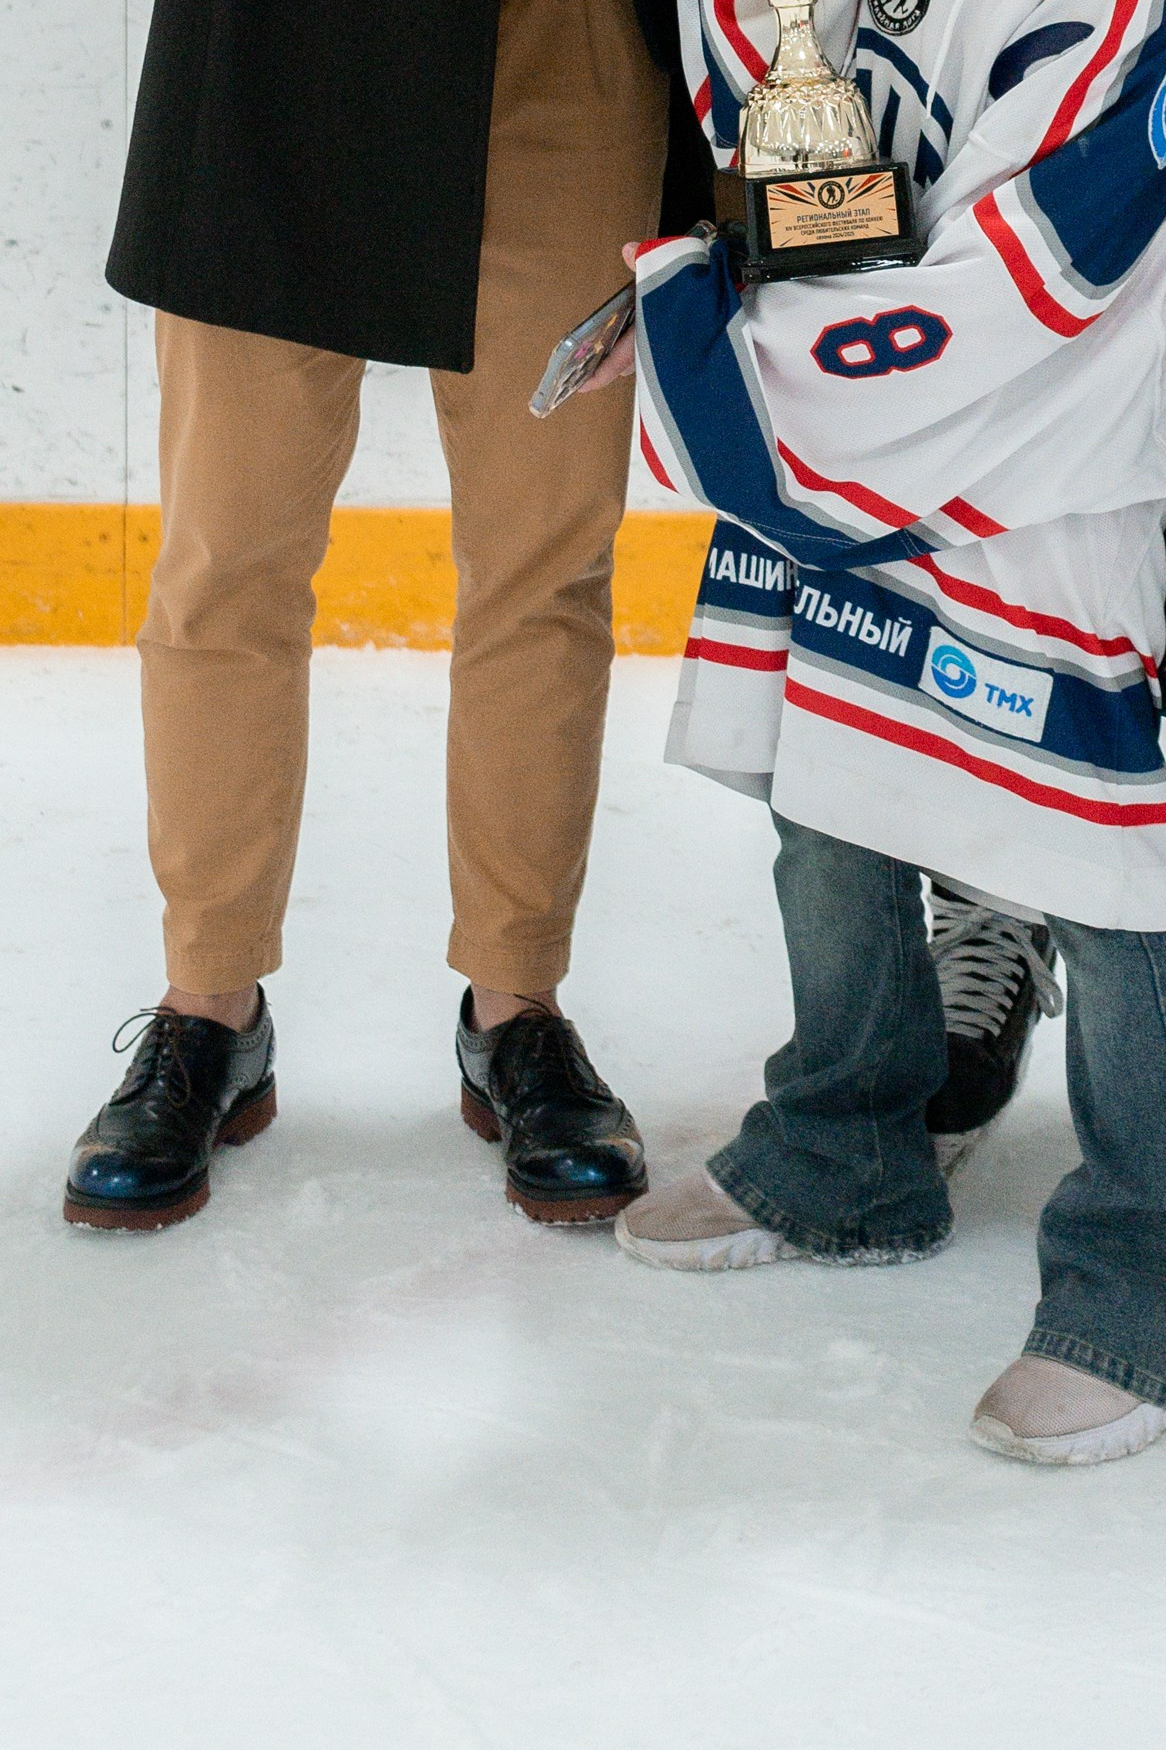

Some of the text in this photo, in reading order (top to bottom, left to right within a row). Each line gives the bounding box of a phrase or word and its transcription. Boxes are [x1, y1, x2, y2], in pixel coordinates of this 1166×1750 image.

[797, 208, 871, 223] РЕГИОНАЛЬНЫЙ ЭТАП
[810, 305, 953, 379] 8
[984, 682, 1035, 718] ТМХ
